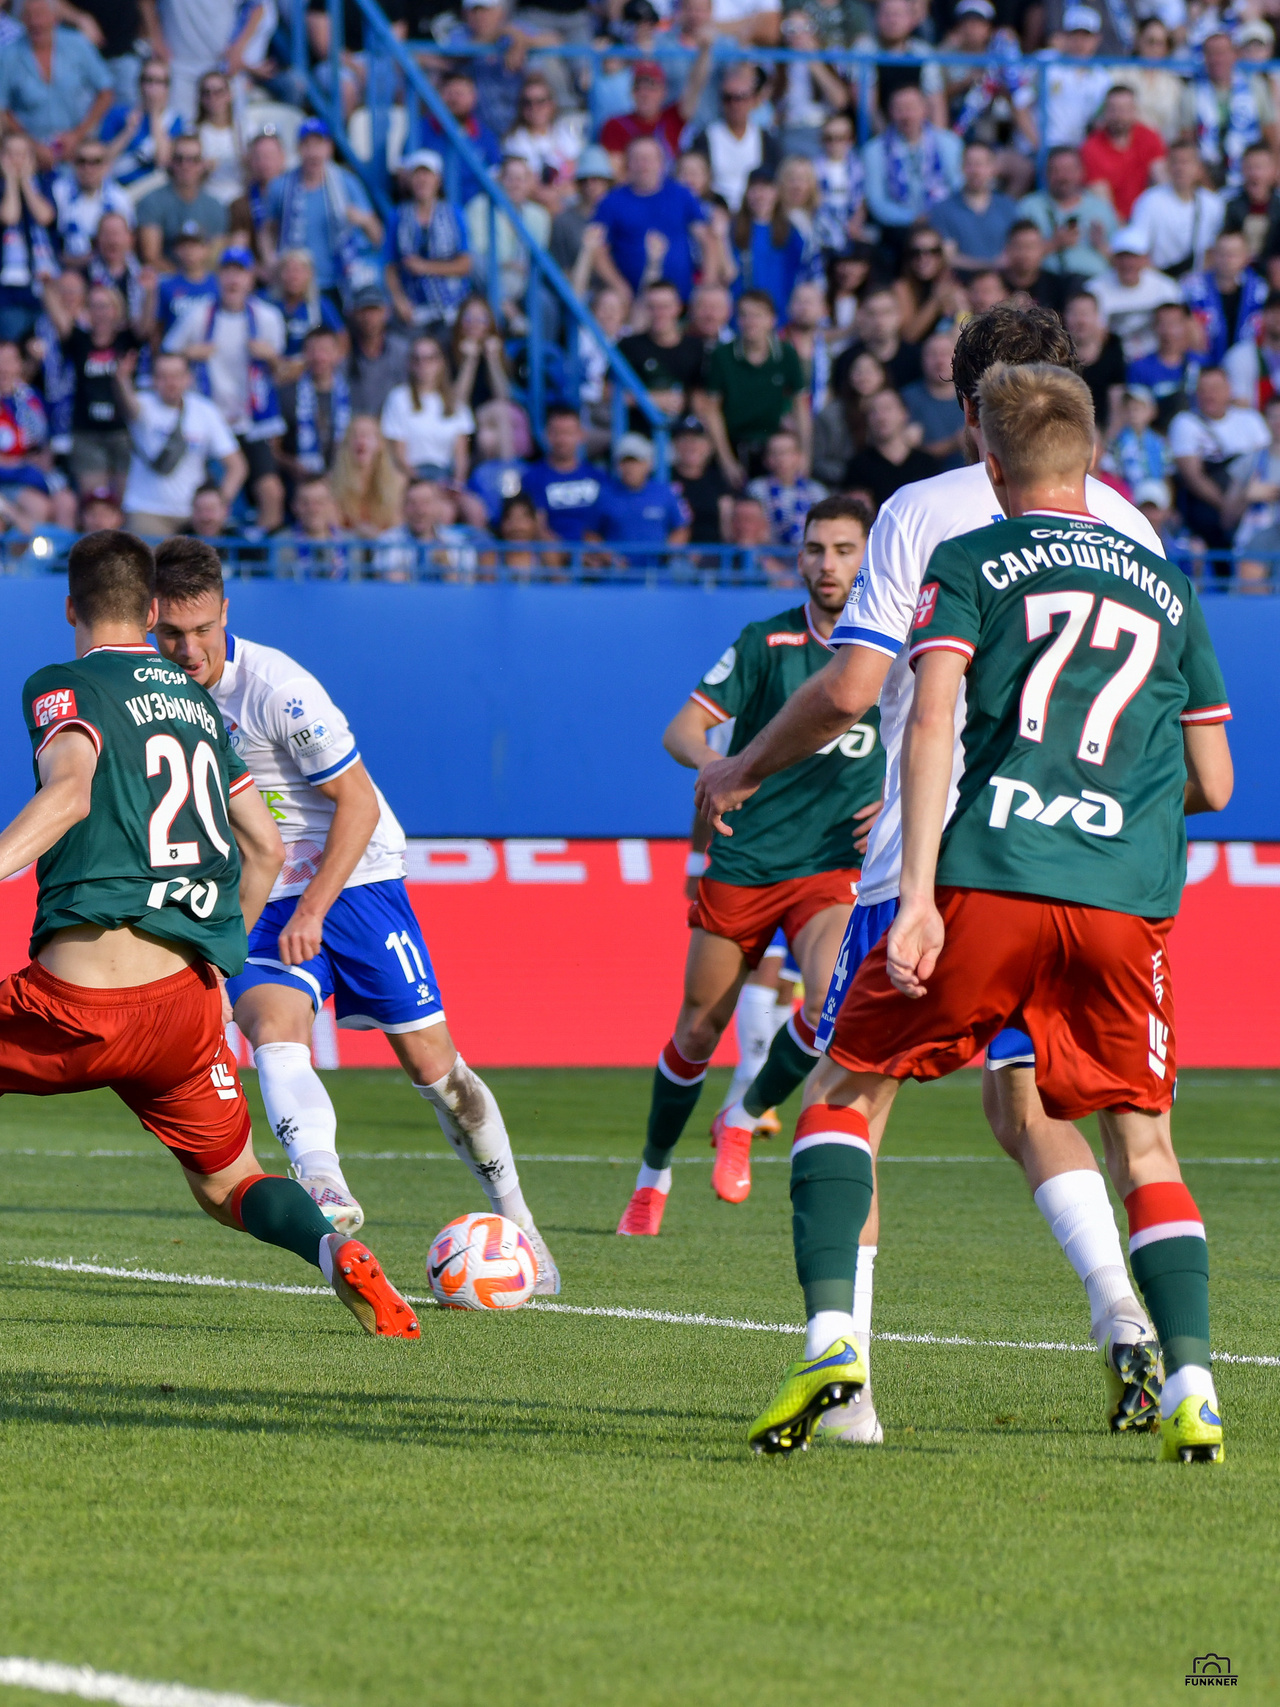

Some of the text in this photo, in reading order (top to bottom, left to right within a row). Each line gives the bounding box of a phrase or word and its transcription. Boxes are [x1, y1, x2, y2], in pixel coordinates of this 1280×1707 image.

[1069, 521, 1094, 531] FCLM
[1030, 528, 1135, 554] САПСАН
[981, 542, 1184, 627] САМОШНИКОВ
[133, 667, 187, 685] САПСАН
[1019, 590, 1160, 766] 77
[36, 690, 70, 717] FON
[39, 702, 72, 727] BET
[145, 733, 231, 868] 20
[384, 930, 427, 984] 11
